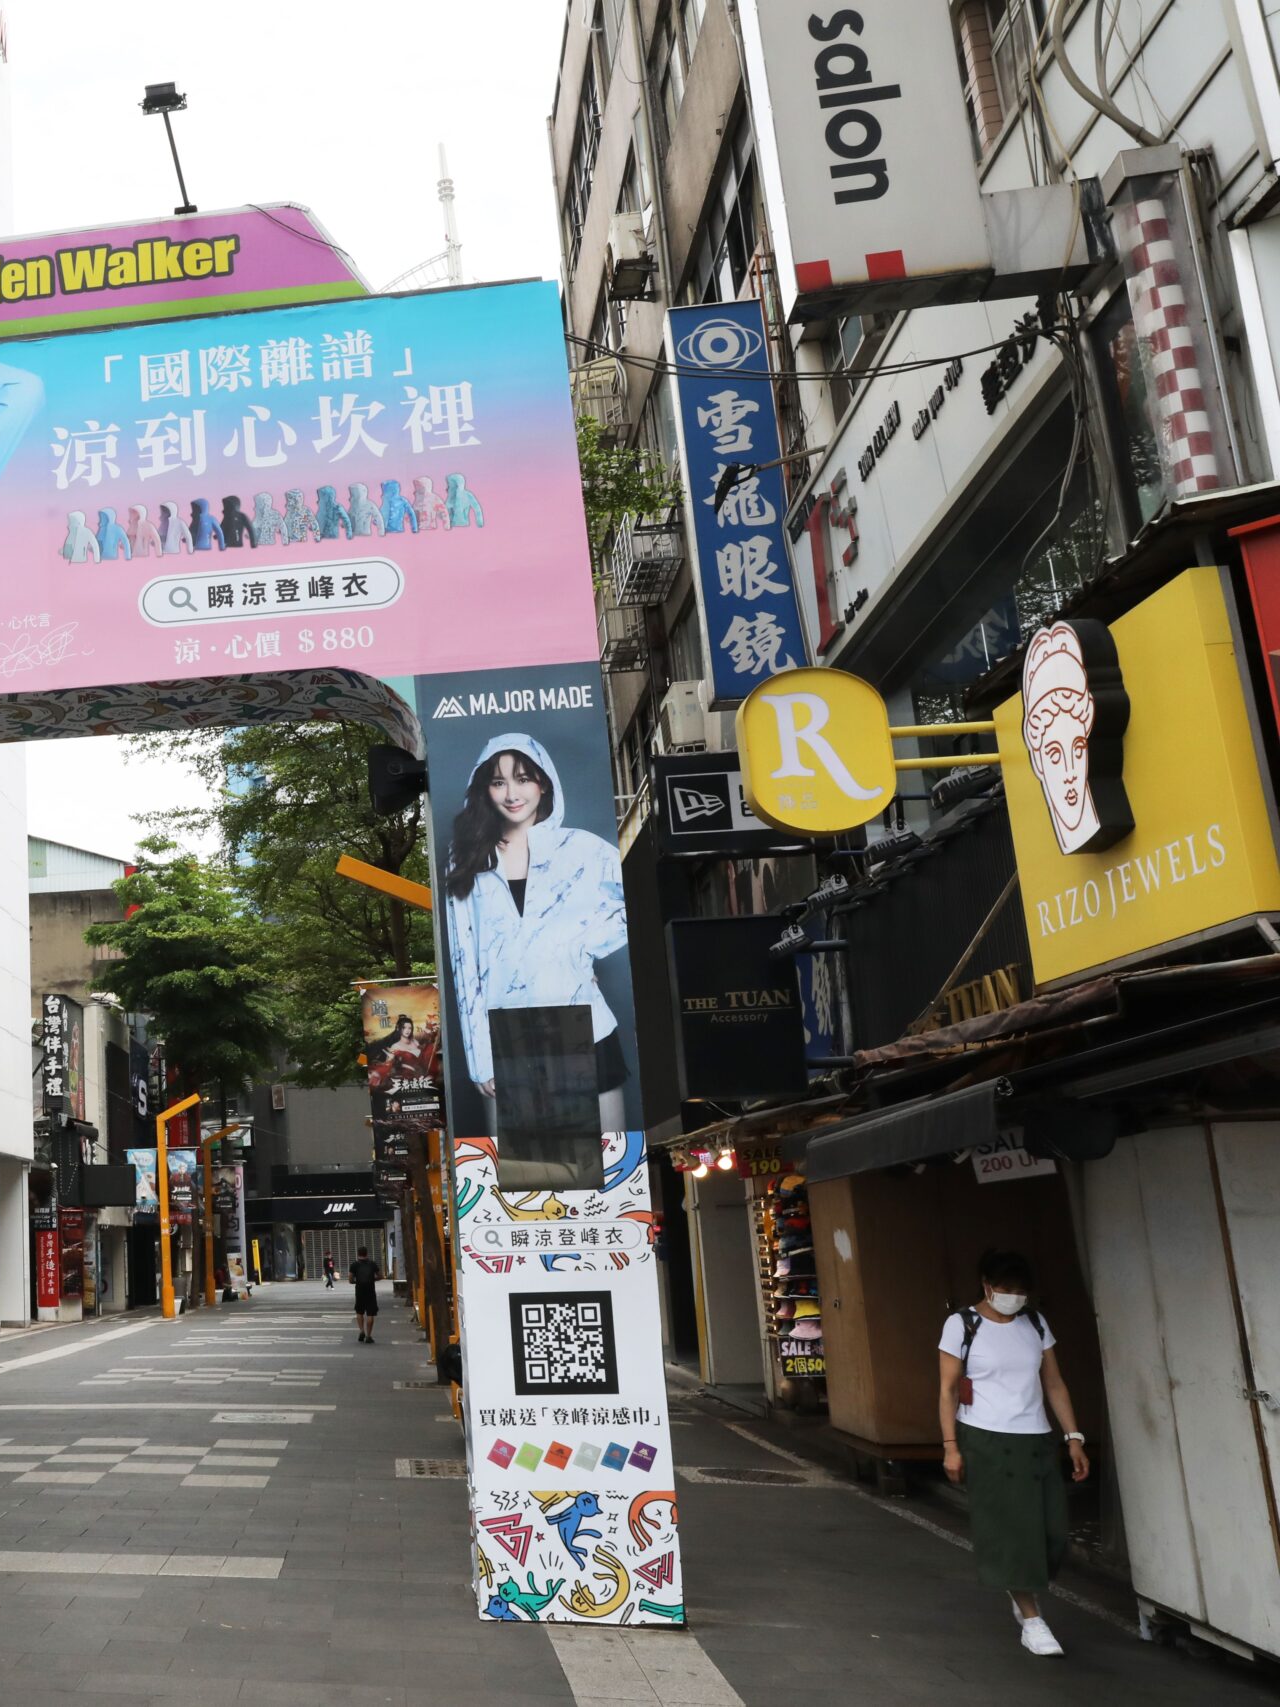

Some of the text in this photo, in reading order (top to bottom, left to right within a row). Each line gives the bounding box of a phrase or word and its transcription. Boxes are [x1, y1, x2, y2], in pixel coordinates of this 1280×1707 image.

[807, 8, 901, 205] salon
[58, 235, 238, 295] Walker
[49, 380, 482, 490] 涼到心坎裡
[697, 390, 798, 675] 雪龍眼鏡
[207, 572, 369, 609] 瞬涼登峰衣
[298, 626, 374, 654] $880
[470, 685, 594, 716] MAJOR MADE
[760, 691, 884, 800] R
[1036, 823, 1227, 937] RIZO JEWELS
[683, 989, 792, 1010] THE TUAN
[710, 1013, 768, 1023] Accessory
[44, 995, 63, 1097] 台灣伴手禮
[742, 1145, 783, 1160] SALE
[981, 1155, 1013, 1173] 200
[749, 1160, 781, 1176] 190
[510, 1226, 624, 1247] 瞬涼登峰衣
[781, 1341, 812, 1356] SALE
[479, 1406, 662, 1428] 買就送「登峰涼感巾」
